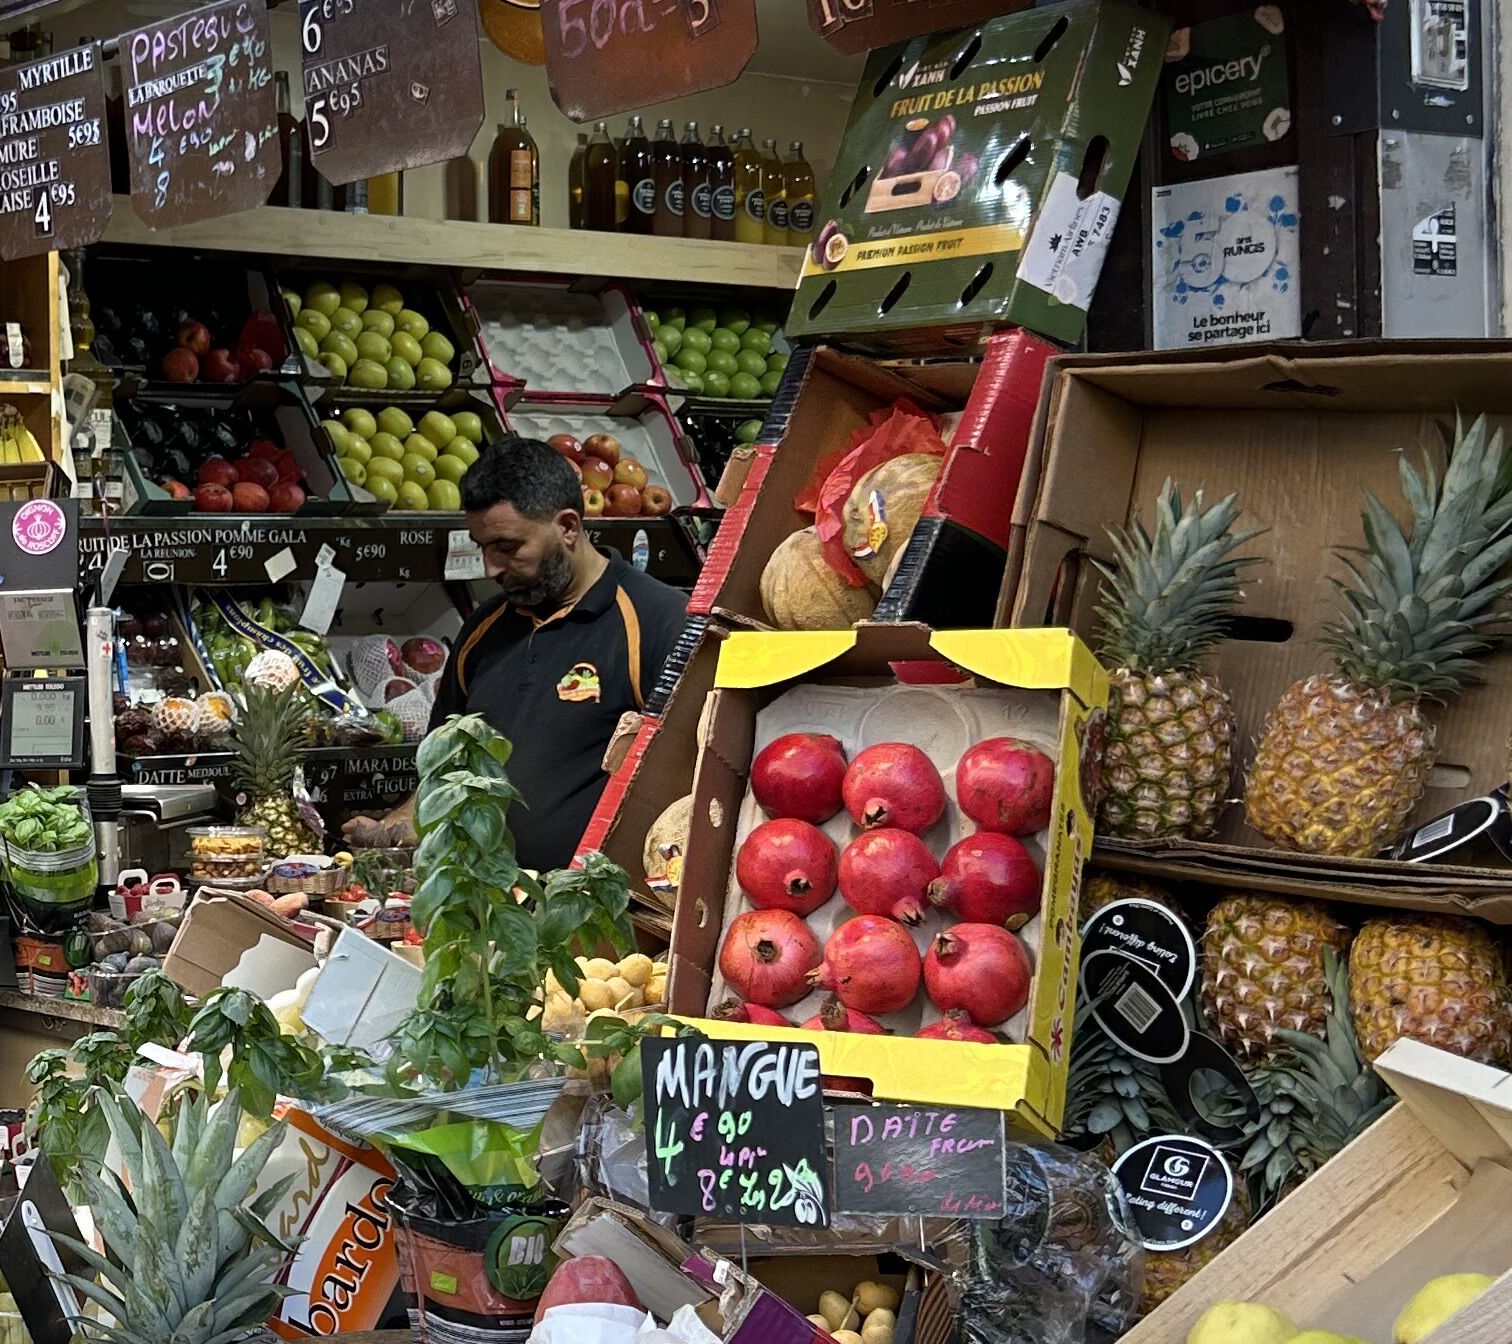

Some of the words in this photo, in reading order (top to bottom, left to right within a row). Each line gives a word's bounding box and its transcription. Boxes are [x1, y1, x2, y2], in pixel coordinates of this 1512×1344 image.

[19, 49, 92, 91] MYRTILLE
[308, 49, 388, 93] ANANAS
[1176, 51, 1264, 96] epicery
[890, 93, 935, 118] FRUIT
[933, 89, 955, 109] DE
[956, 85, 975, 105] LA
[976, 70, 1045, 101] PASSION
[1011, 94, 1038, 110] FRUIT
[0, 101, 84, 137] FRAMBOISE
[1044, 243, 1070, 287] Vietnam
[1062, 207, 1086, 243] Airlines
[1193, 316, 1208, 329] Le
[1209, 311, 1266, 327] bonheur
[1188, 331, 1203, 342] se
[1204, 325, 1254, 343] partage
[109, 535, 129, 550] DE
[132, 534, 152, 549] LA
[155, 529, 212, 546] PASSION
[214, 529, 265, 544] POMME
[268, 529, 307, 543] GALA
[400, 531, 434, 545] ROSE
[348, 758, 389, 774] MARA
[392, 757, 417, 771] DES
[138, 769, 185, 785] DATTE
[376, 778, 417, 794] FIGUE
[1049, 803, 1065, 929] POMEGRANATES
[656, 1042, 819, 1109] MANGUE
[1150, 1173, 1193, 1188] GLAMOUR
